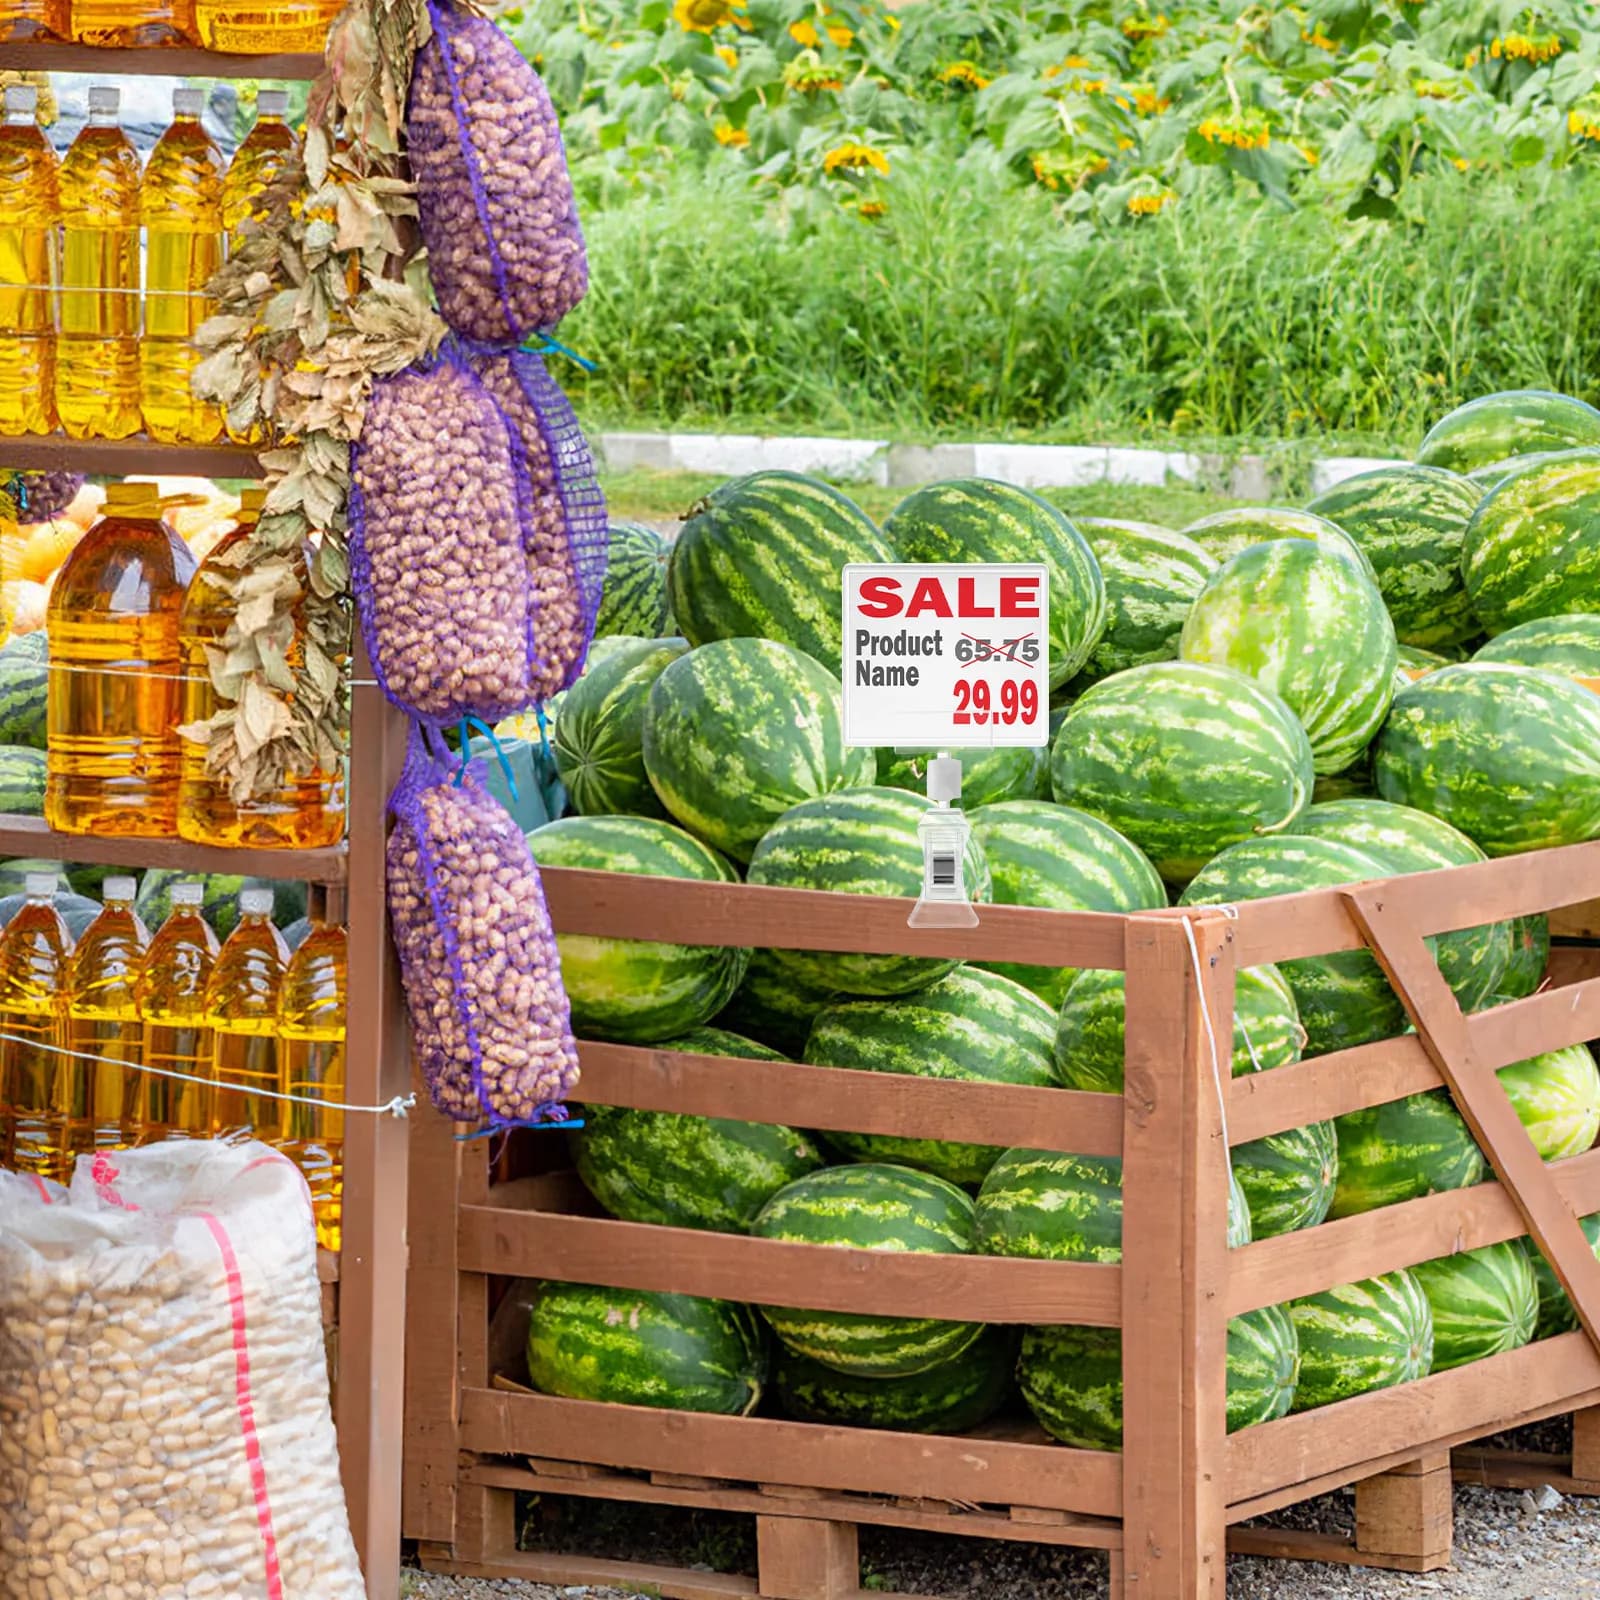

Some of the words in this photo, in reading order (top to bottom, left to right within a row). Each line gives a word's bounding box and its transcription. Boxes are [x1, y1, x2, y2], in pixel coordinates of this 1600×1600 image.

[857, 577, 1040, 618] SALE
[856, 629, 943, 656] Product
[954, 638, 1040, 662] 65.75
[856, 660, 919, 687] Name
[953, 679, 1039, 725] 29.99
